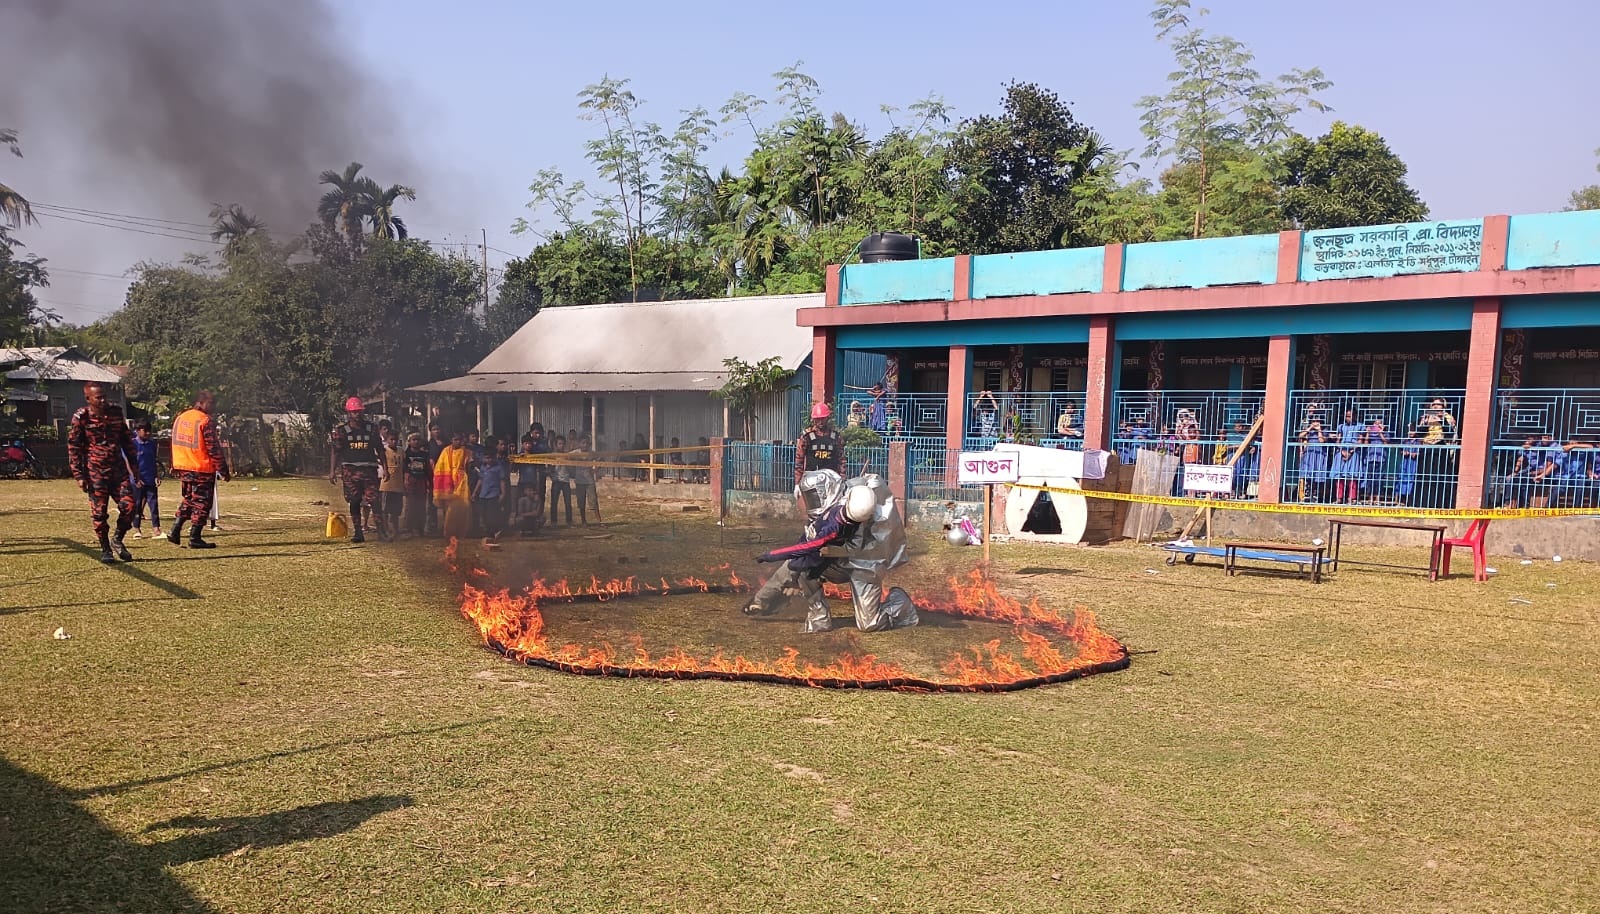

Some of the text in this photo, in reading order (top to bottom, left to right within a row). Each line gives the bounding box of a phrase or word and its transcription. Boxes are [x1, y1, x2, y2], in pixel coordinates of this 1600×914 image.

[1359, 225, 1410, 243] সরকারি
[1436, 223, 1482, 240] বিদ্যালয়
[964, 458, 1013, 475] আগুন
